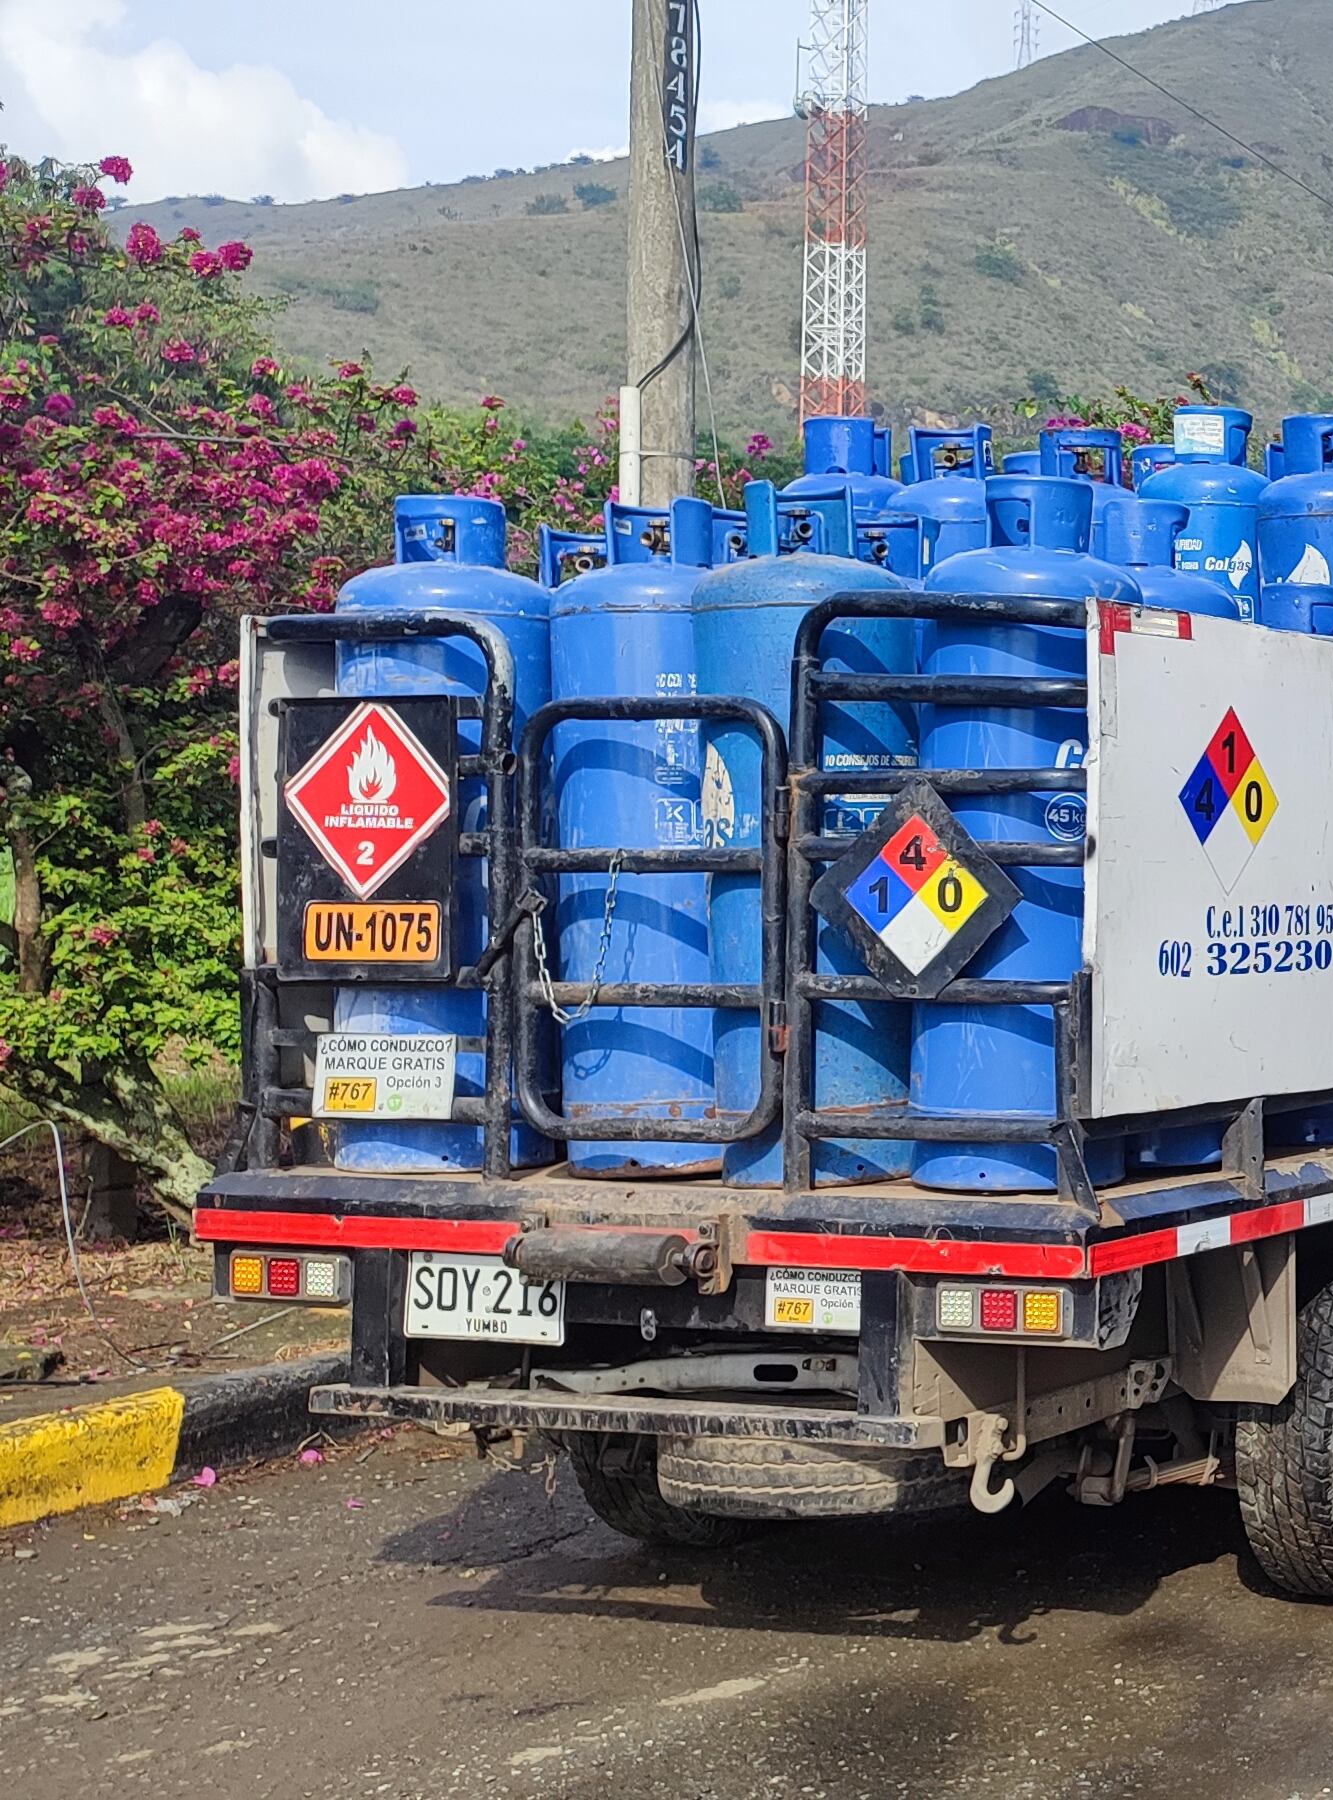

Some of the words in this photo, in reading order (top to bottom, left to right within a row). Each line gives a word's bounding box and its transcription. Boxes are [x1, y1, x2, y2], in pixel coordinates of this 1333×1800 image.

[1204, 556, 1251, 574] Colgas
[1221, 731, 1235, 773] 1
[1194, 778, 1215, 821] 4
[1245, 780, 1263, 823] 0
[340, 803, 400, 817] LIQUIDO
[1048, 809, 1070, 823] 45
[324, 815, 415, 830] INFLAMABLE
[355, 840, 376, 866] 2
[899, 834, 928, 872] 4
[868, 876, 889, 914] 1
[937, 876, 963, 913] 0
[1250, 904, 1280, 938] 310
[1285, 905, 1311, 937] 781
[315, 912, 432, 952] UN-1075
[1158, 940, 1192, 978] 602
[321, 1036, 367, 1055] ¿CÓMO
[370, 1037, 453, 1053] CONDUZCO?
[324, 1057, 387, 1071] MARQUE
[392, 1057, 445, 1071] GRATIS
[328, 1082, 372, 1101] #767
[386, 1075, 431, 1091] Opción
[434, 1077, 442, 1089] 3
[769, 1267, 805, 1281] ¿CÓMO
[807, 1271, 862, 1283] CONDUZCO
[773, 1282, 821, 1295] MARQUE
[777, 1301, 811, 1316] #767
[820, 1298, 854, 1309] Opción
[465, 1318, 508, 1334] YUMBO
